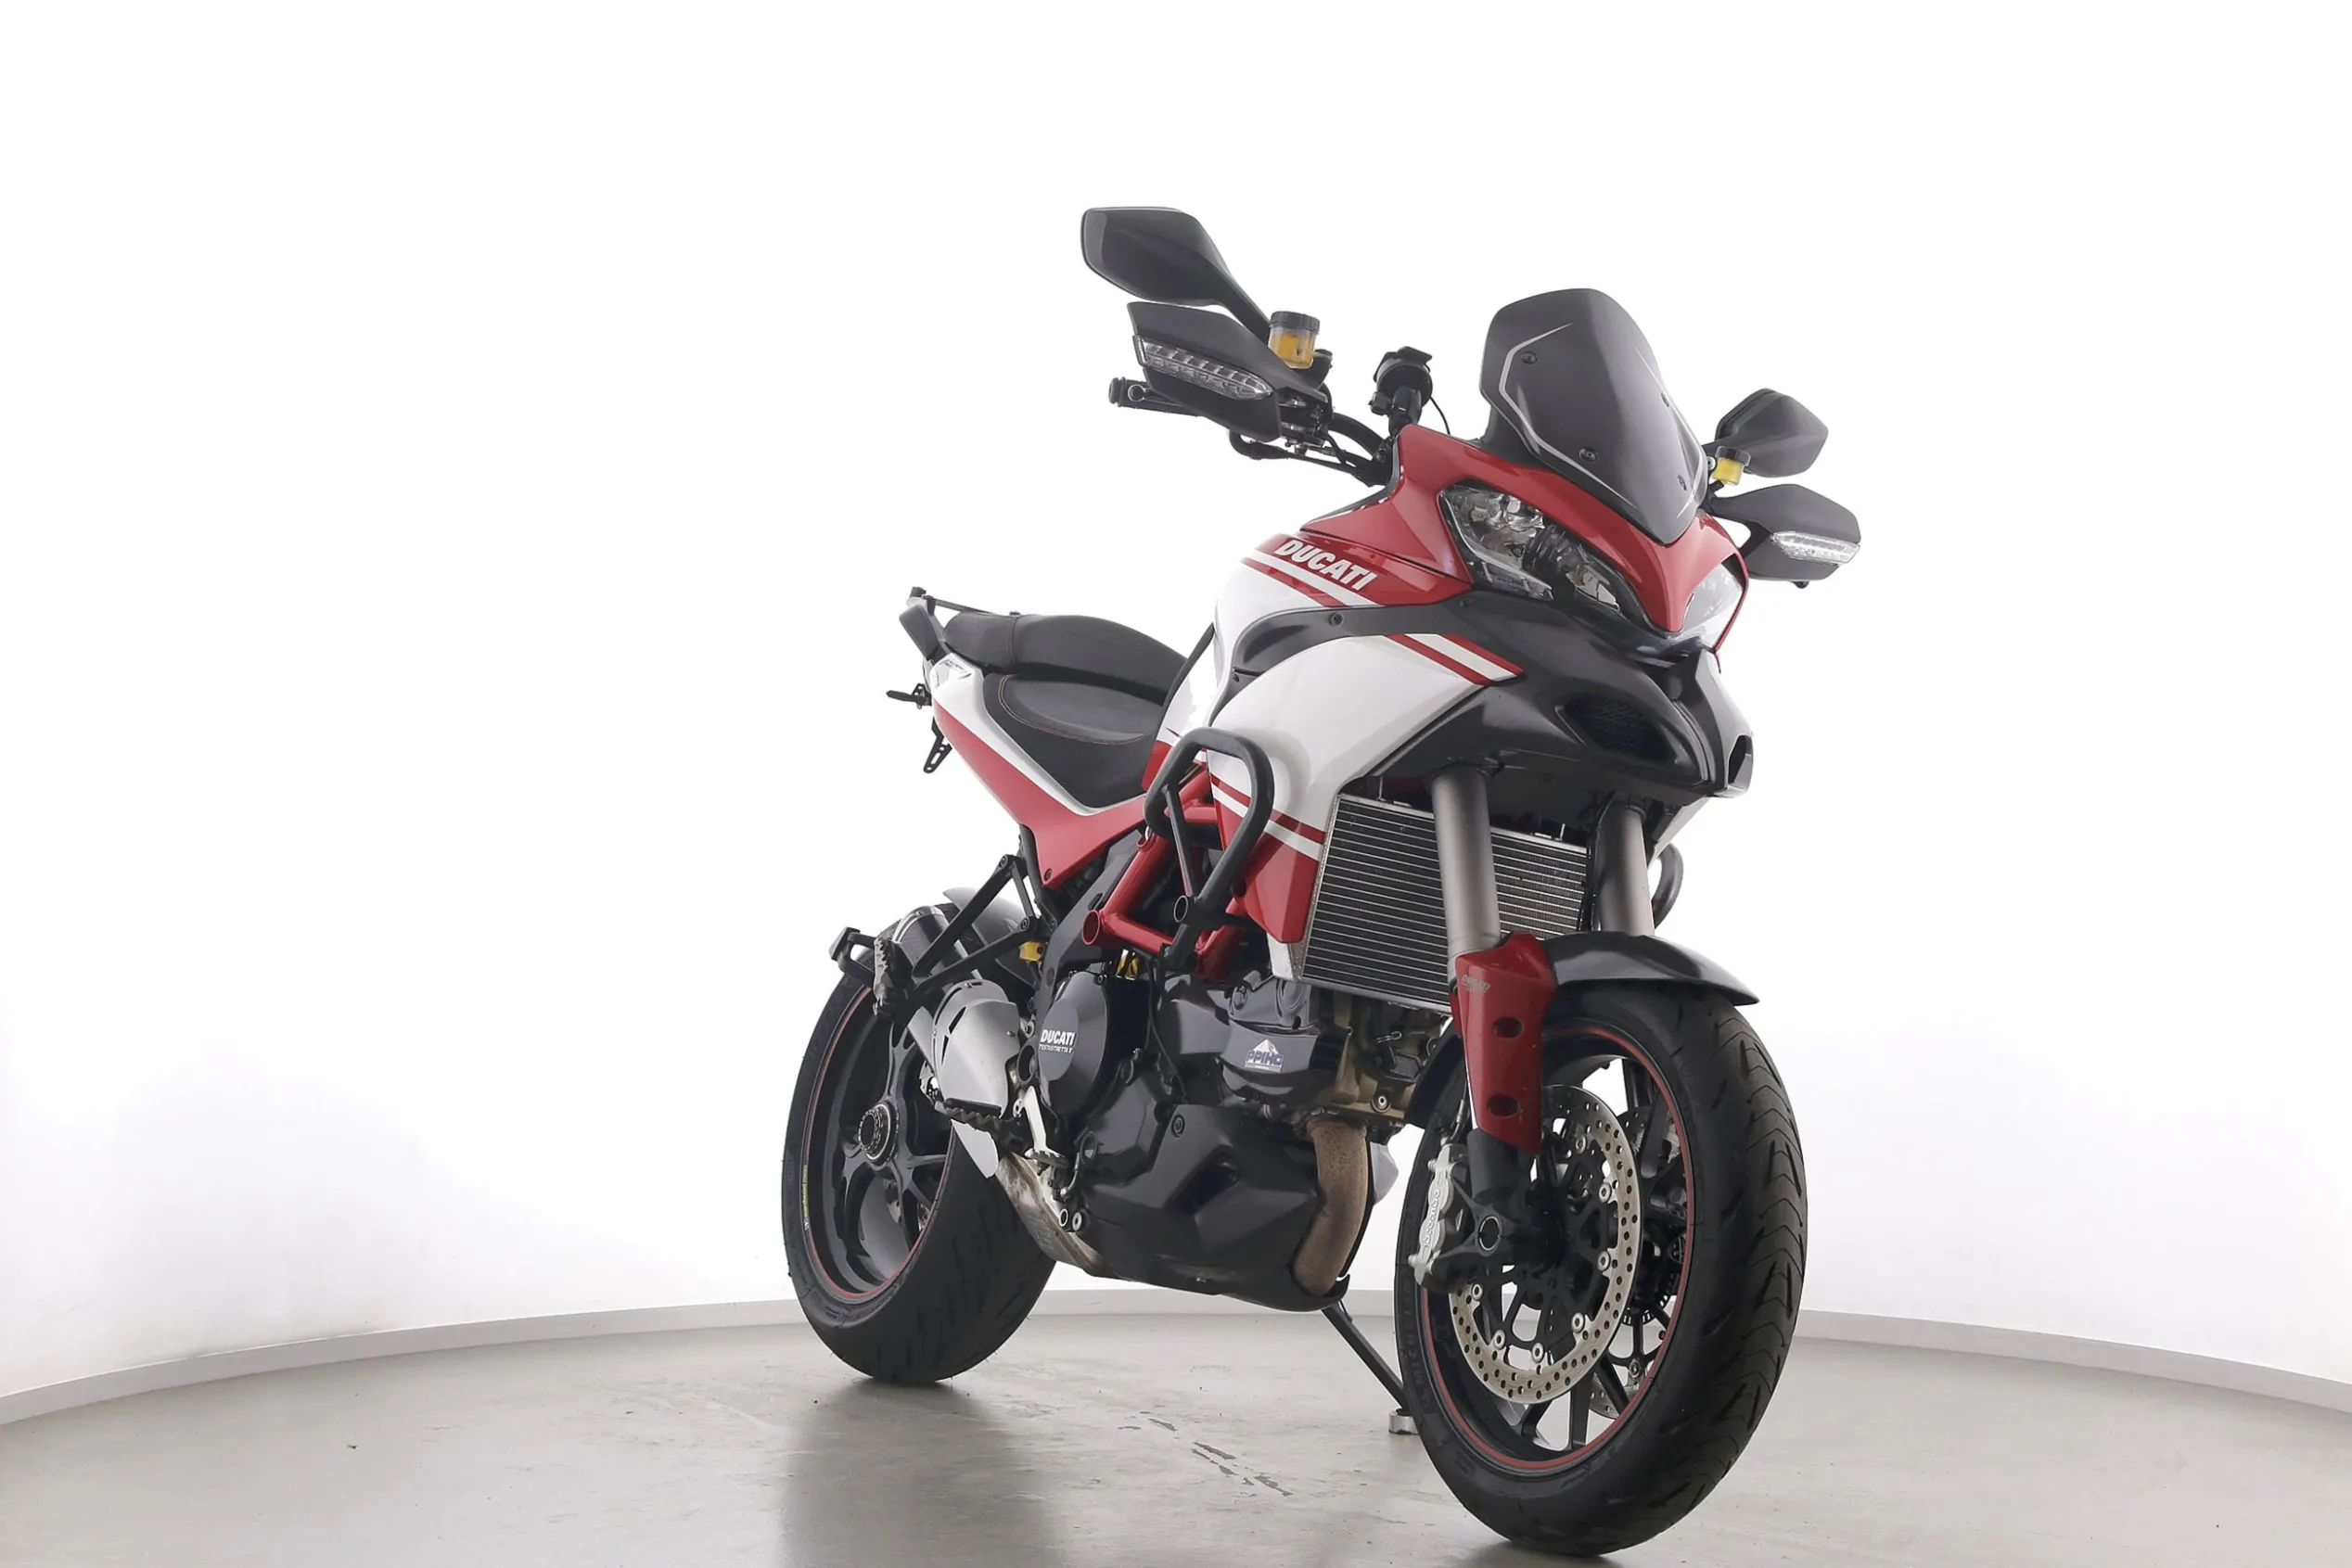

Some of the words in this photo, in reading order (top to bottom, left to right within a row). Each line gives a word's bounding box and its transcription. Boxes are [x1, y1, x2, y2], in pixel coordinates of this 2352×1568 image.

[1274, 539, 1378, 591] DUCATI
[1462, 975, 1491, 991] DUTI
[1040, 1029, 1076, 1046] DUCATI
